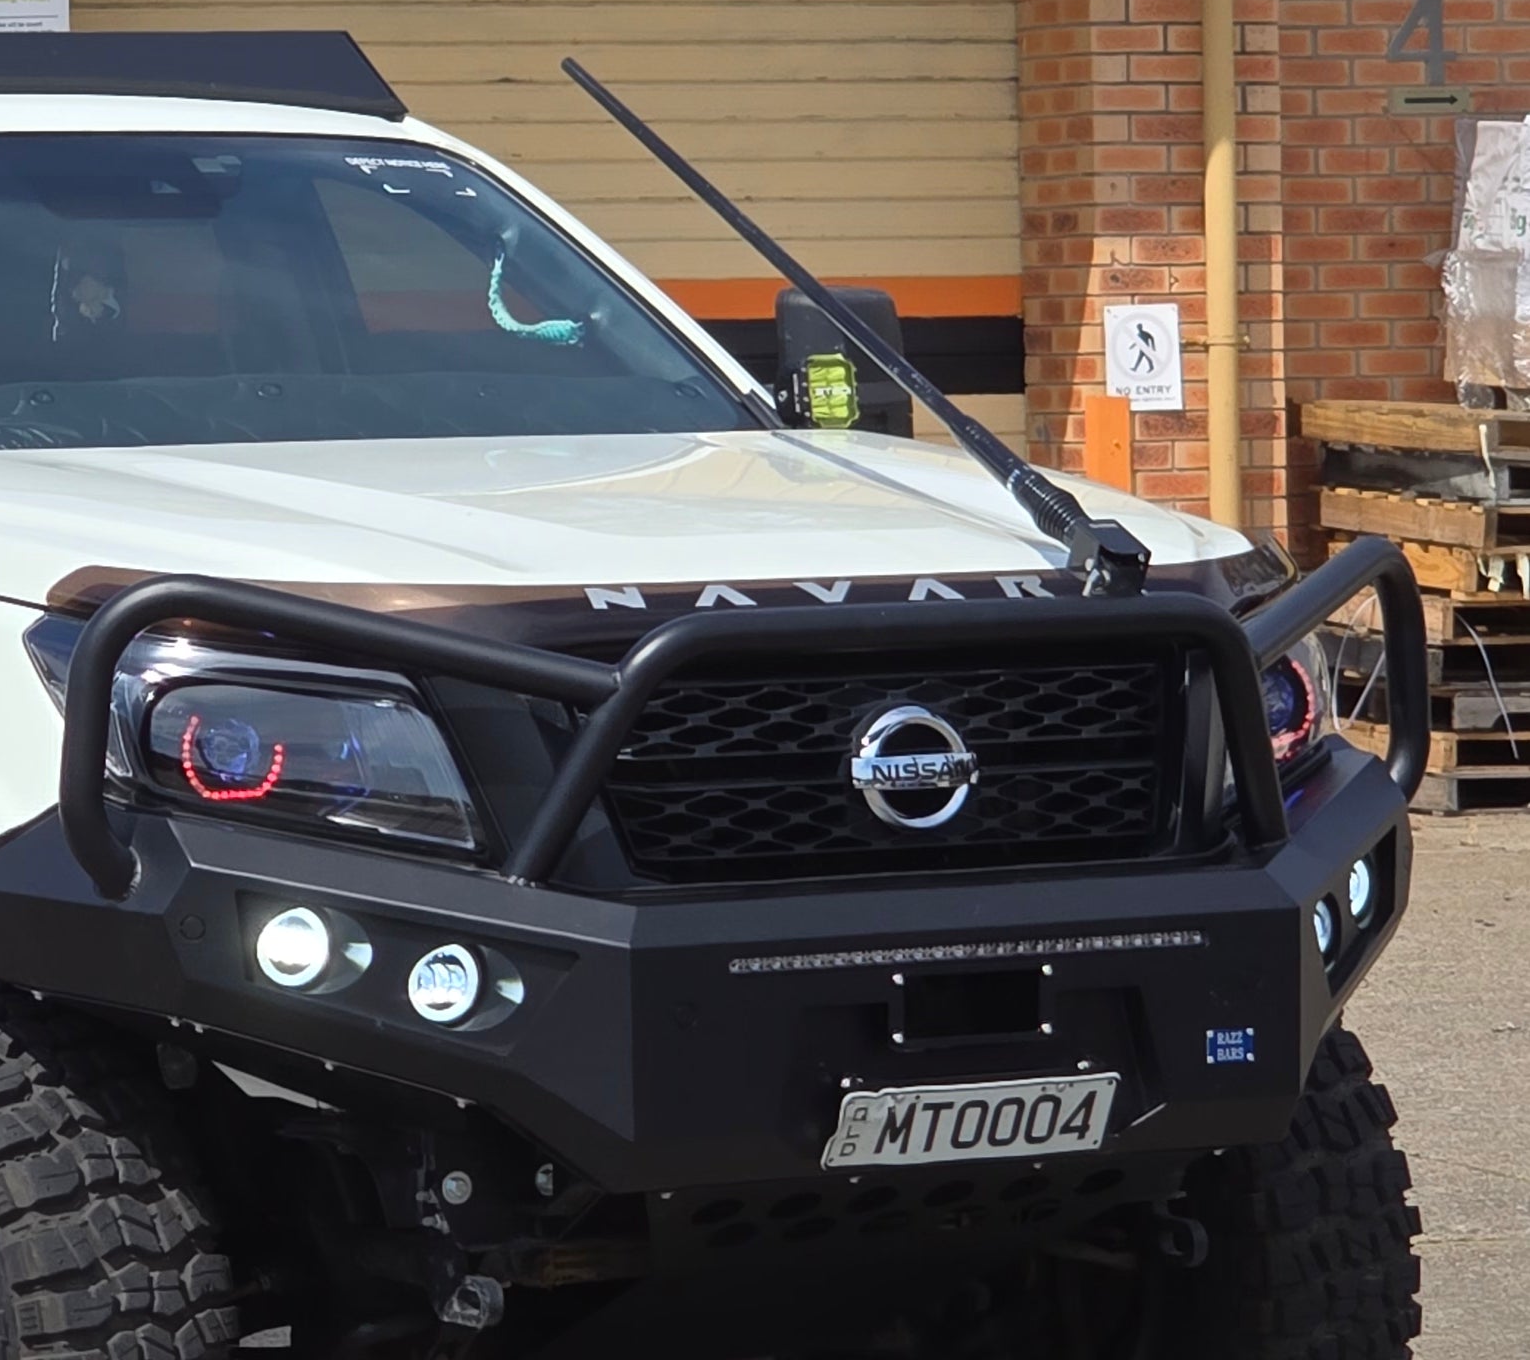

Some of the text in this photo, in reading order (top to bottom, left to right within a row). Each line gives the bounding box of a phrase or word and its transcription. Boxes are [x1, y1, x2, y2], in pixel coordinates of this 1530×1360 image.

[1115, 385, 1173, 397] NO ENTRY
[583, 575, 1056, 610] NAVAR
[871, 757, 977, 782] NISSAN
[1216, 1030, 1244, 1045] RAZZ
[1216, 1046, 1245, 1061] BARS
